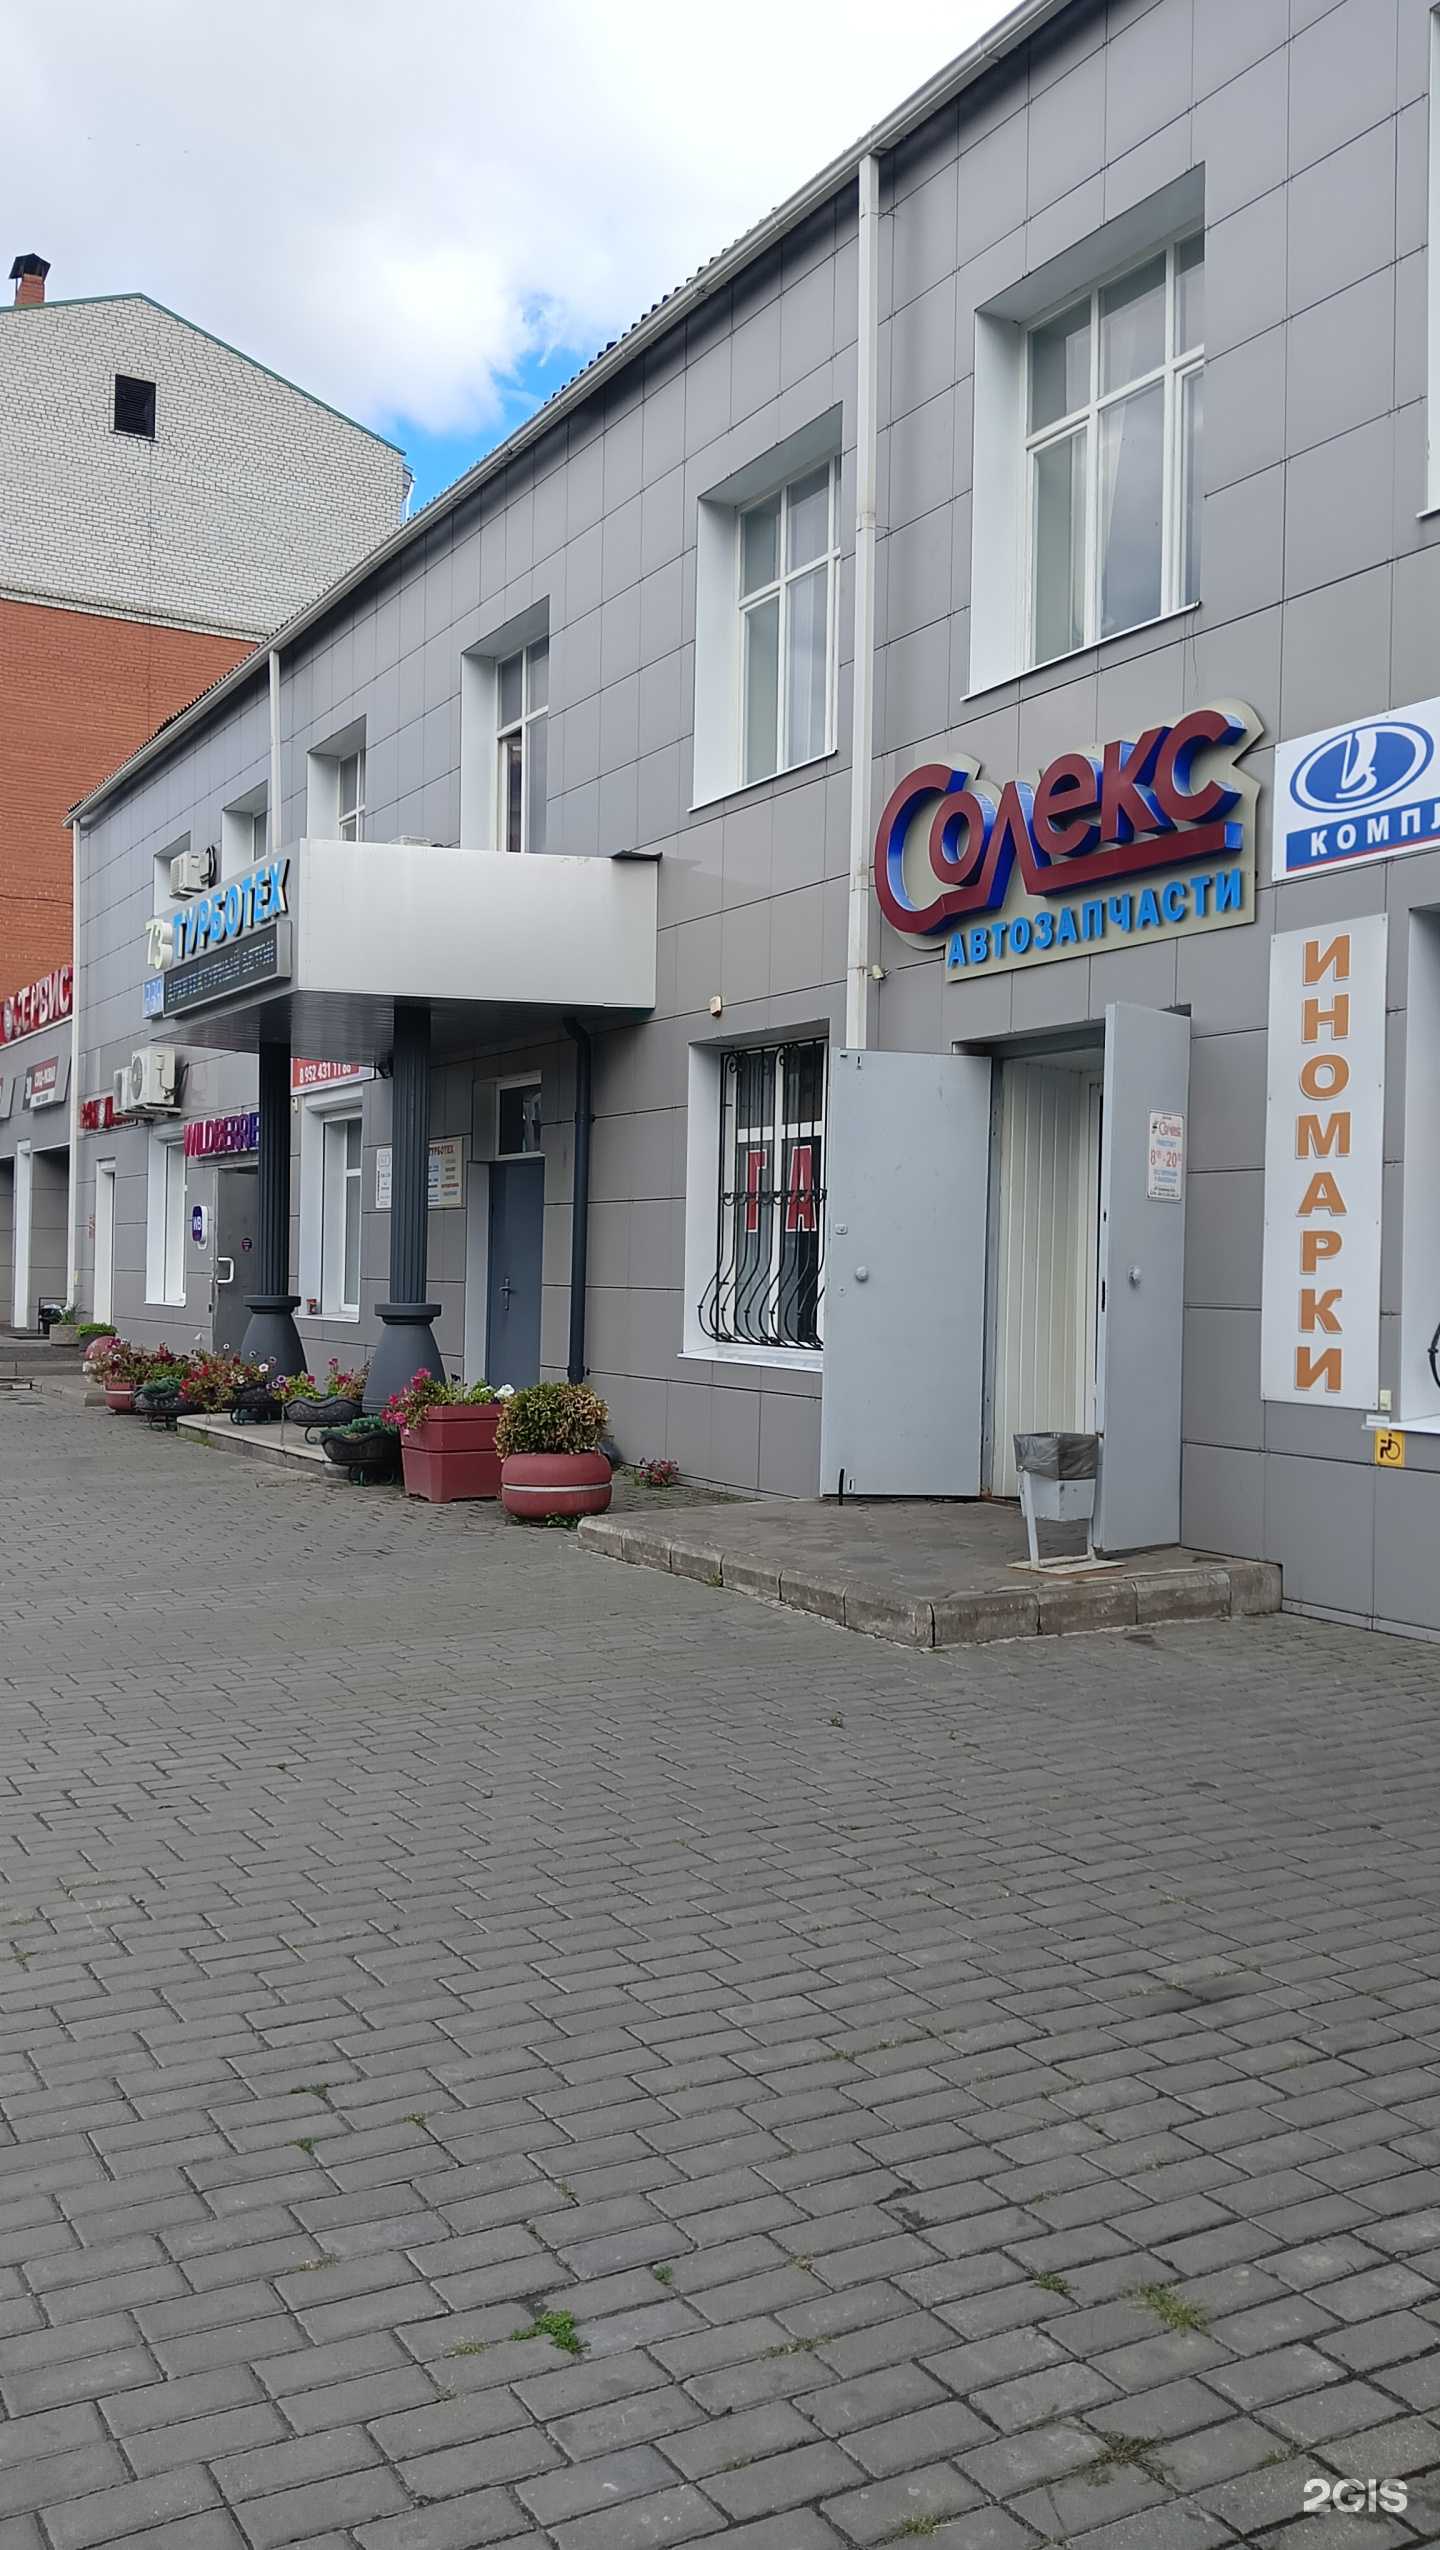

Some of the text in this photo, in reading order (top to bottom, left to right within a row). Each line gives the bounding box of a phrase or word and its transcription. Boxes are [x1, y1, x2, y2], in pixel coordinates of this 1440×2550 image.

[172, 857, 291, 960] ТУРБОТЕХ
[946, 868, 1243, 969] АВТОЗАПЧАСТИ
[1295, 934, 1352, 1394] ИНОМАРКИ
